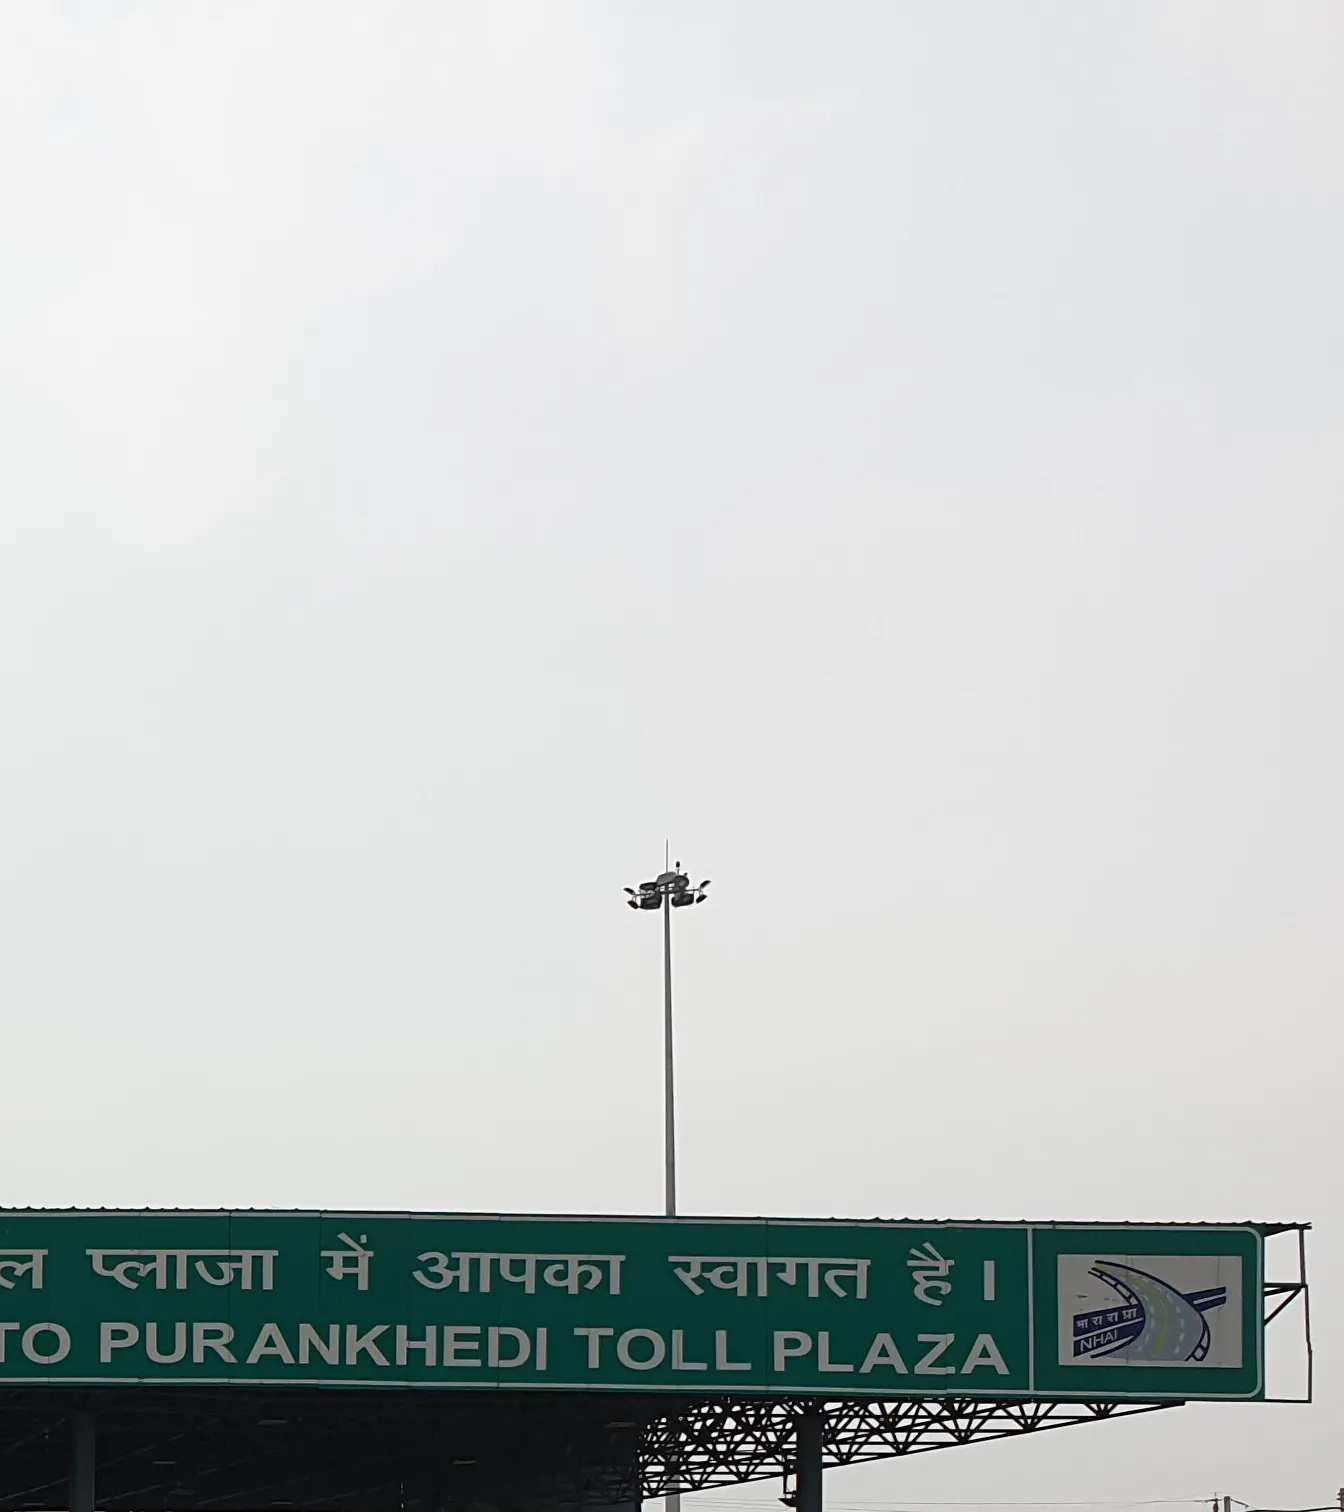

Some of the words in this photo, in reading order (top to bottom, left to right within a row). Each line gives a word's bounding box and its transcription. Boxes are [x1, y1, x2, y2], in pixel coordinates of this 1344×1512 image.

[86, 1249, 278, 1290] प्लाजा
[321, 1233, 374, 1290] में
[413, 1252, 626, 1294] आपका
[668, 1256, 871, 1299] स्वागत
[101, 1322, 547, 1370] PURANKHEDI
[574, 1328, 752, 1370] TOLL
[774, 1331, 1009, 1374] PLAZA
[1080, 1330, 1118, 1352] NHAI
